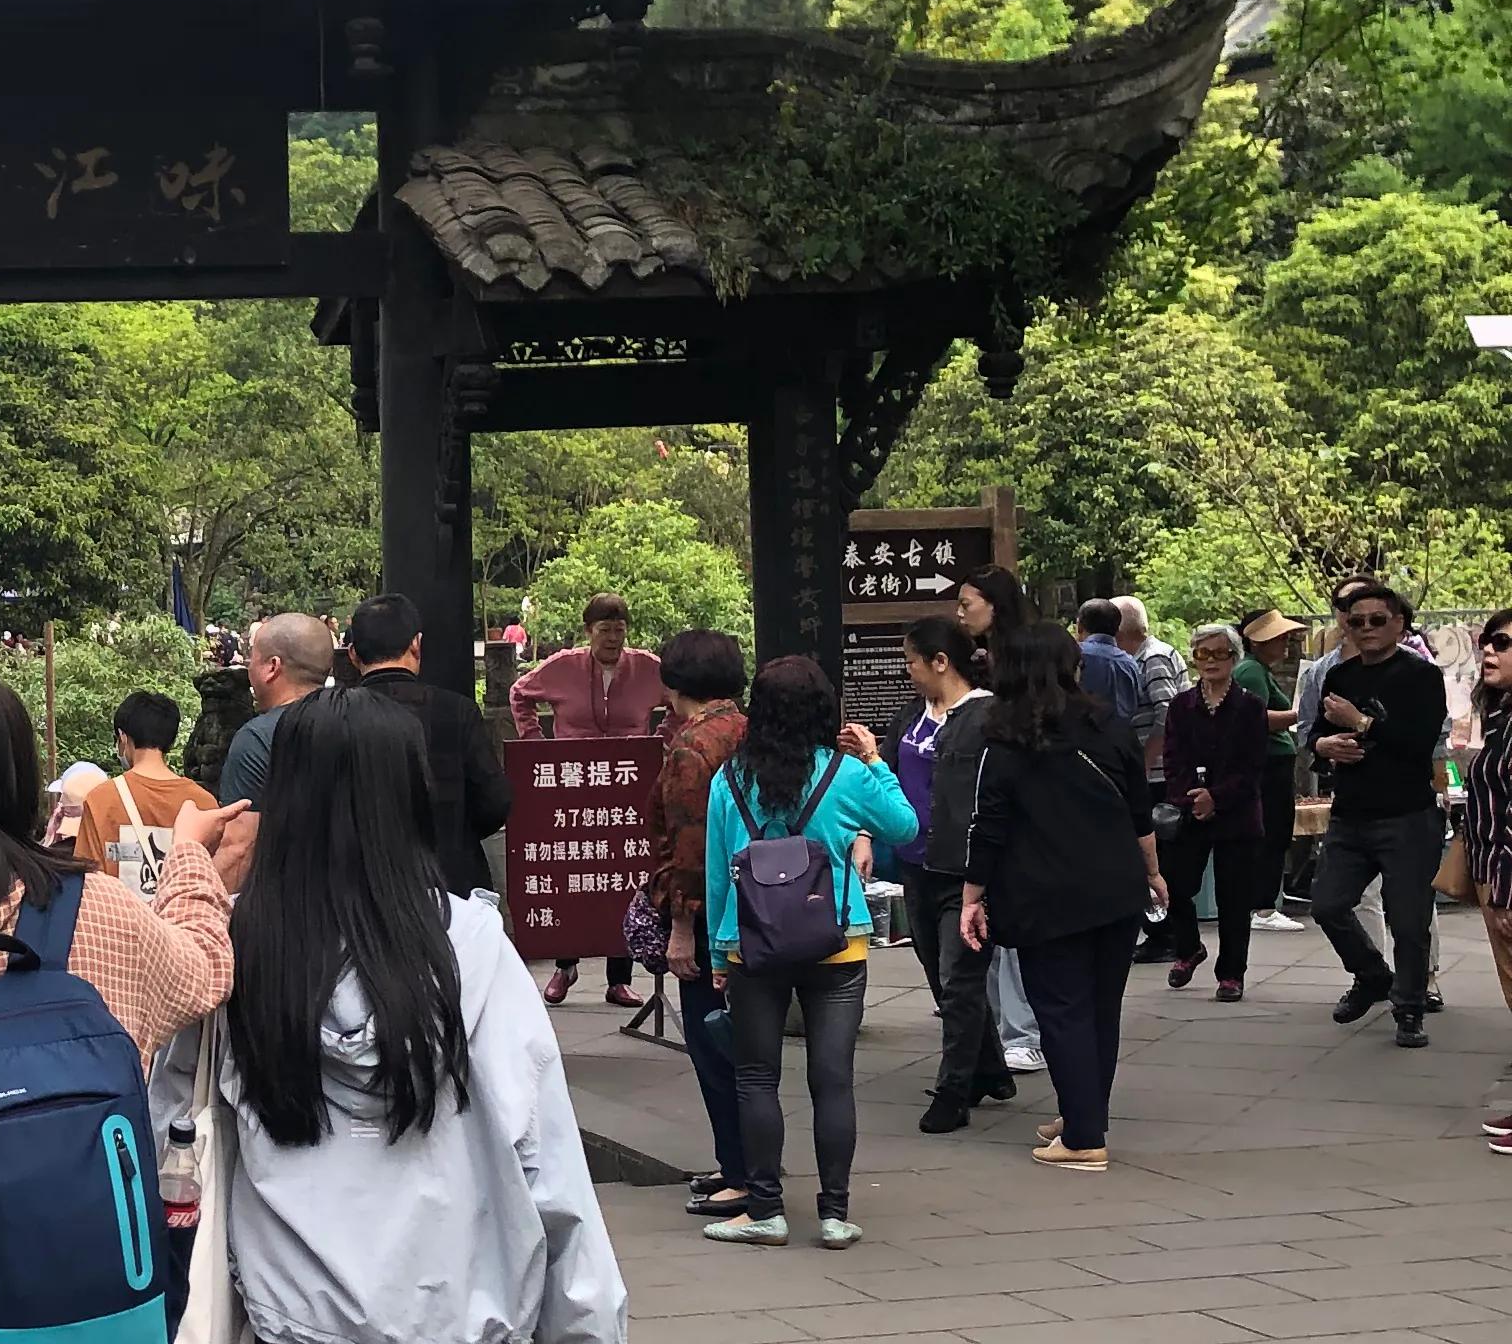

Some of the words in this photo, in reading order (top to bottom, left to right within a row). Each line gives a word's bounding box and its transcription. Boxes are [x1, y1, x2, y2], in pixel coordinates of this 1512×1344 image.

[532, 760, 639, 788] 温馨提示
[553, 806, 644, 828] 为了您的安全，
[524, 837, 651, 862] 请勿摇晃索桥，依次
[526, 907, 561, 928] 小孩。
